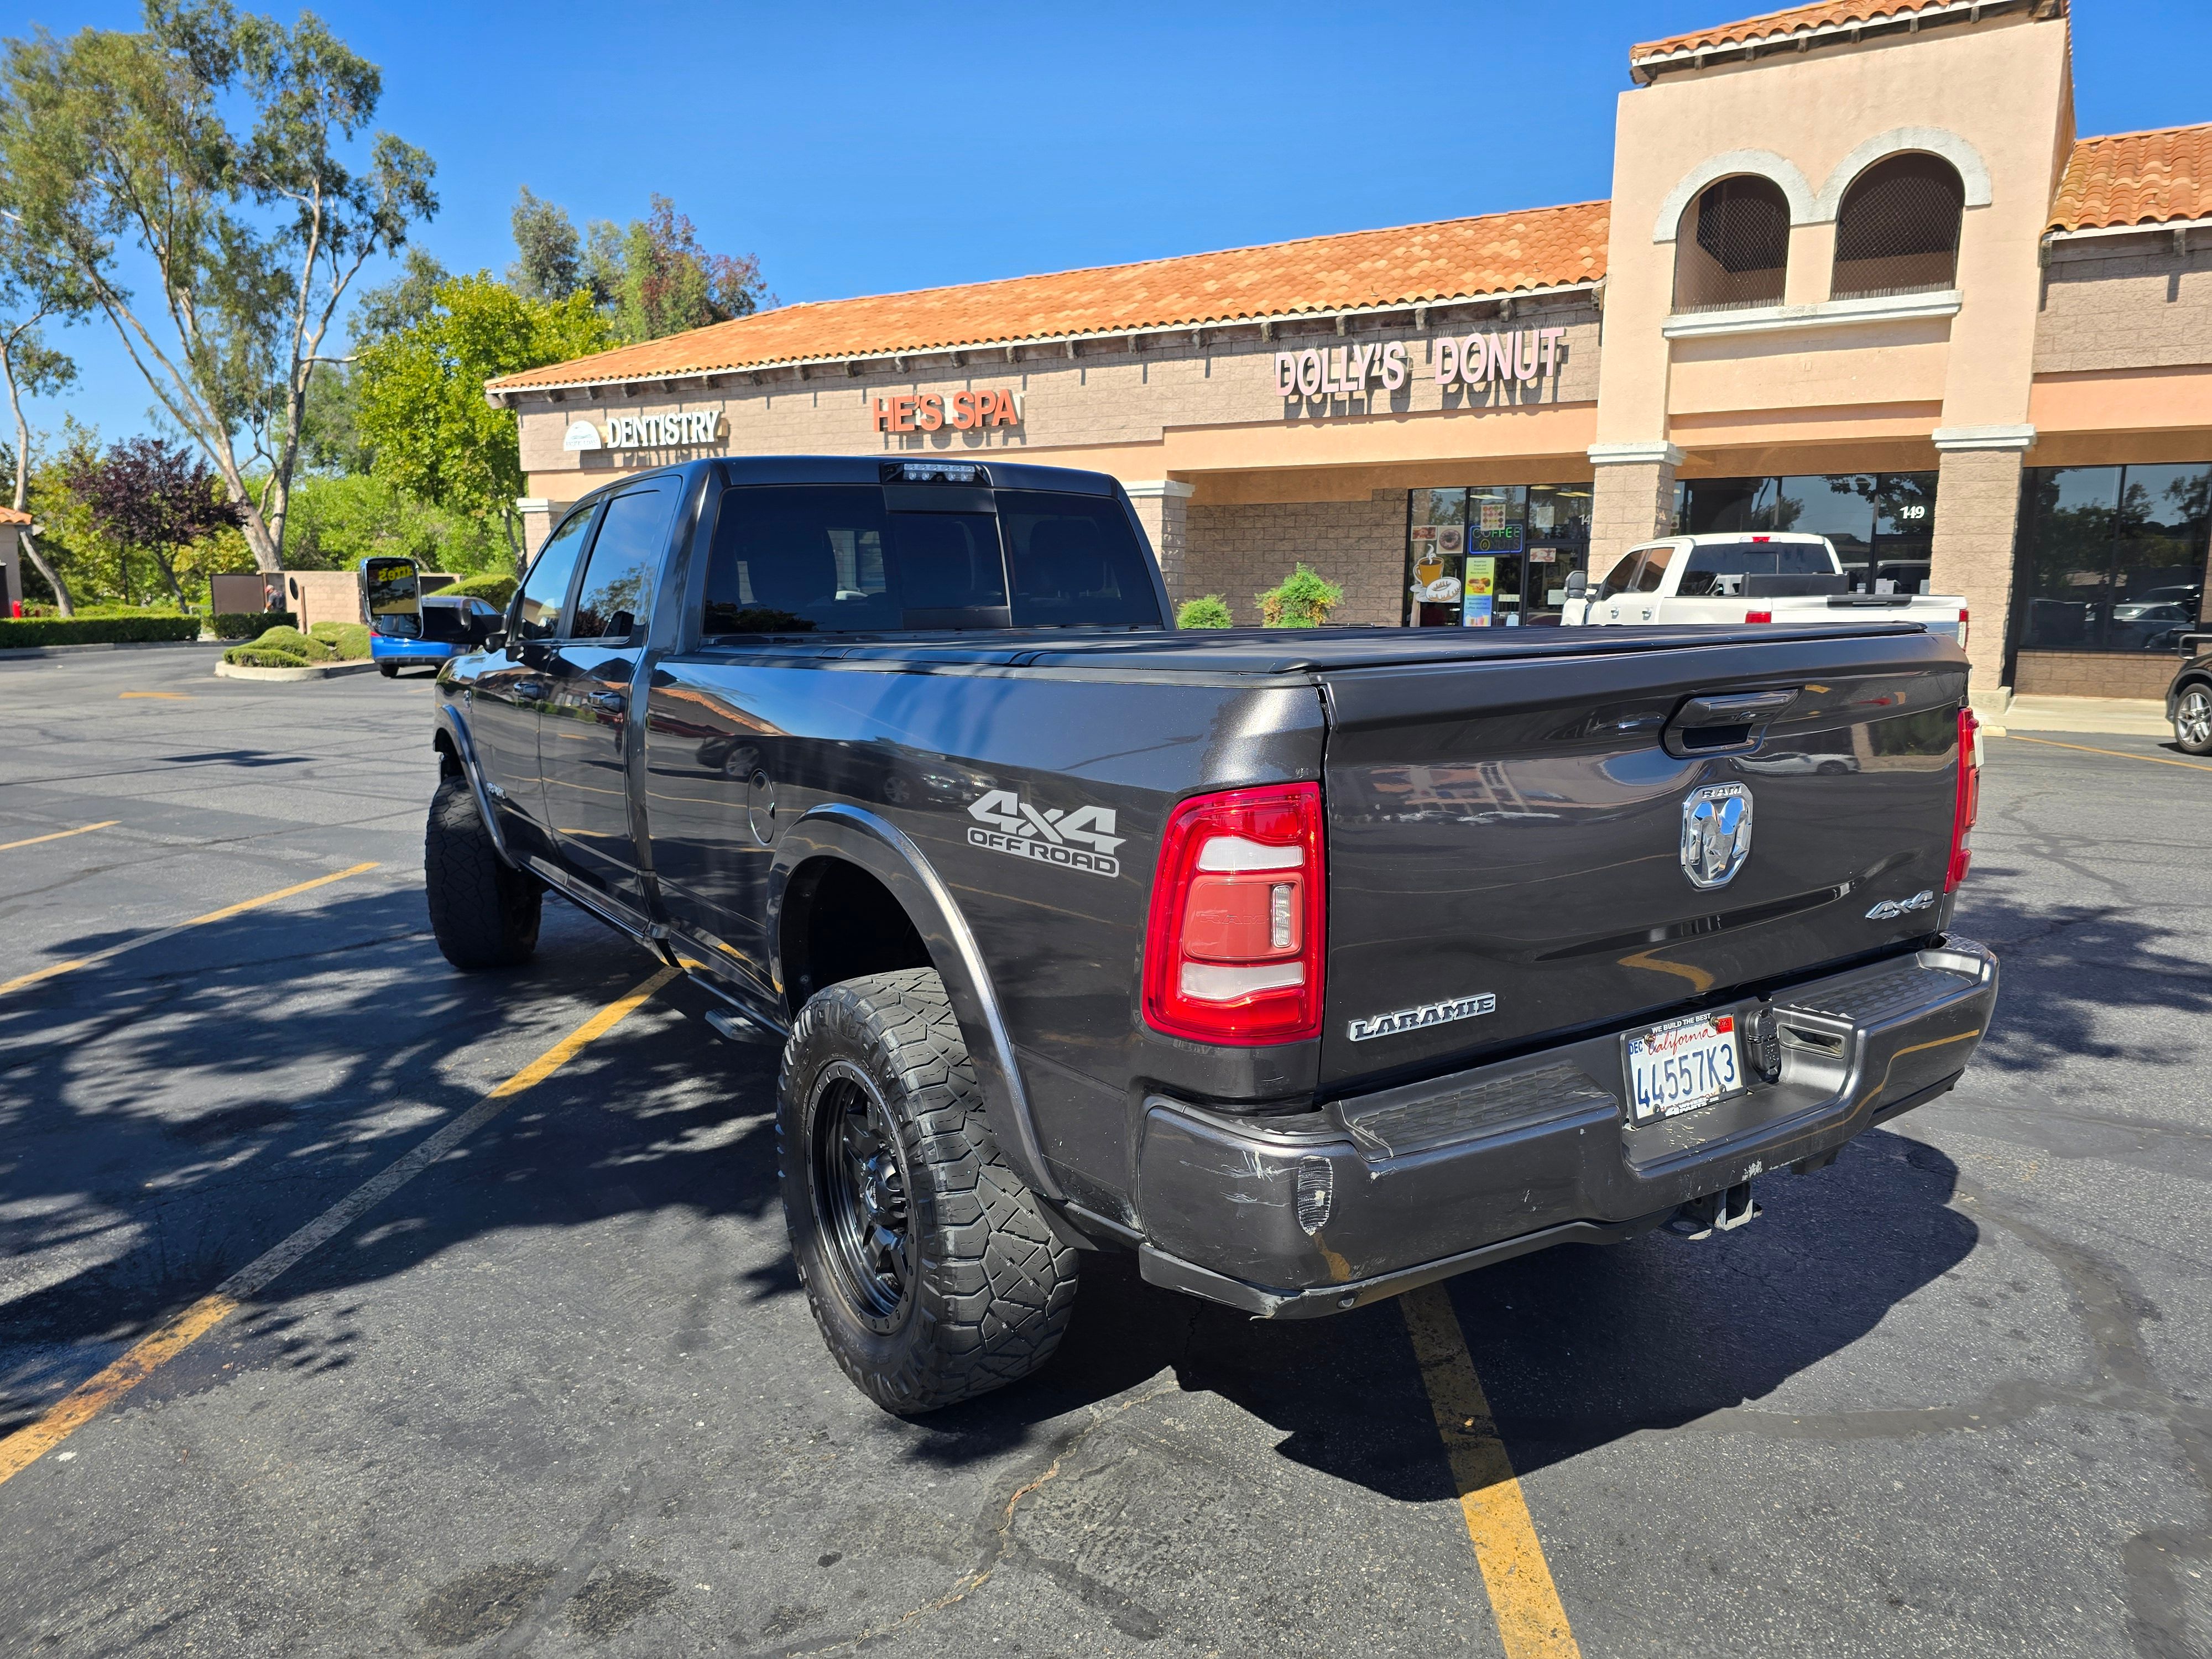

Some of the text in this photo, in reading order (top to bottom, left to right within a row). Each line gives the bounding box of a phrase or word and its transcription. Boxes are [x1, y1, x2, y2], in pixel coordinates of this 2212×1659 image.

[1275, 327, 1566, 396] DOLLY'S DONUT
[873, 389, 1018, 432] HE'S SPA
[607, 410, 719, 448] DENTISTRY
[1899, 505, 1925, 519] 149
[1472, 526, 1520, 538] COFFEE
[1702, 786, 1742, 799] RAM
[969, 829, 1117, 874] OFF ROAD
[1199, 914, 1266, 925] RAM
[1350, 994, 1495, 1041] LARAMIE
[1651, 1013, 1712, 1034] WE BUILD THE BEST
[1629, 1040, 1643, 1055] DEC
[1648, 1027, 1717, 1056] California
[1637, 1044, 1735, 1109] 44557K3
